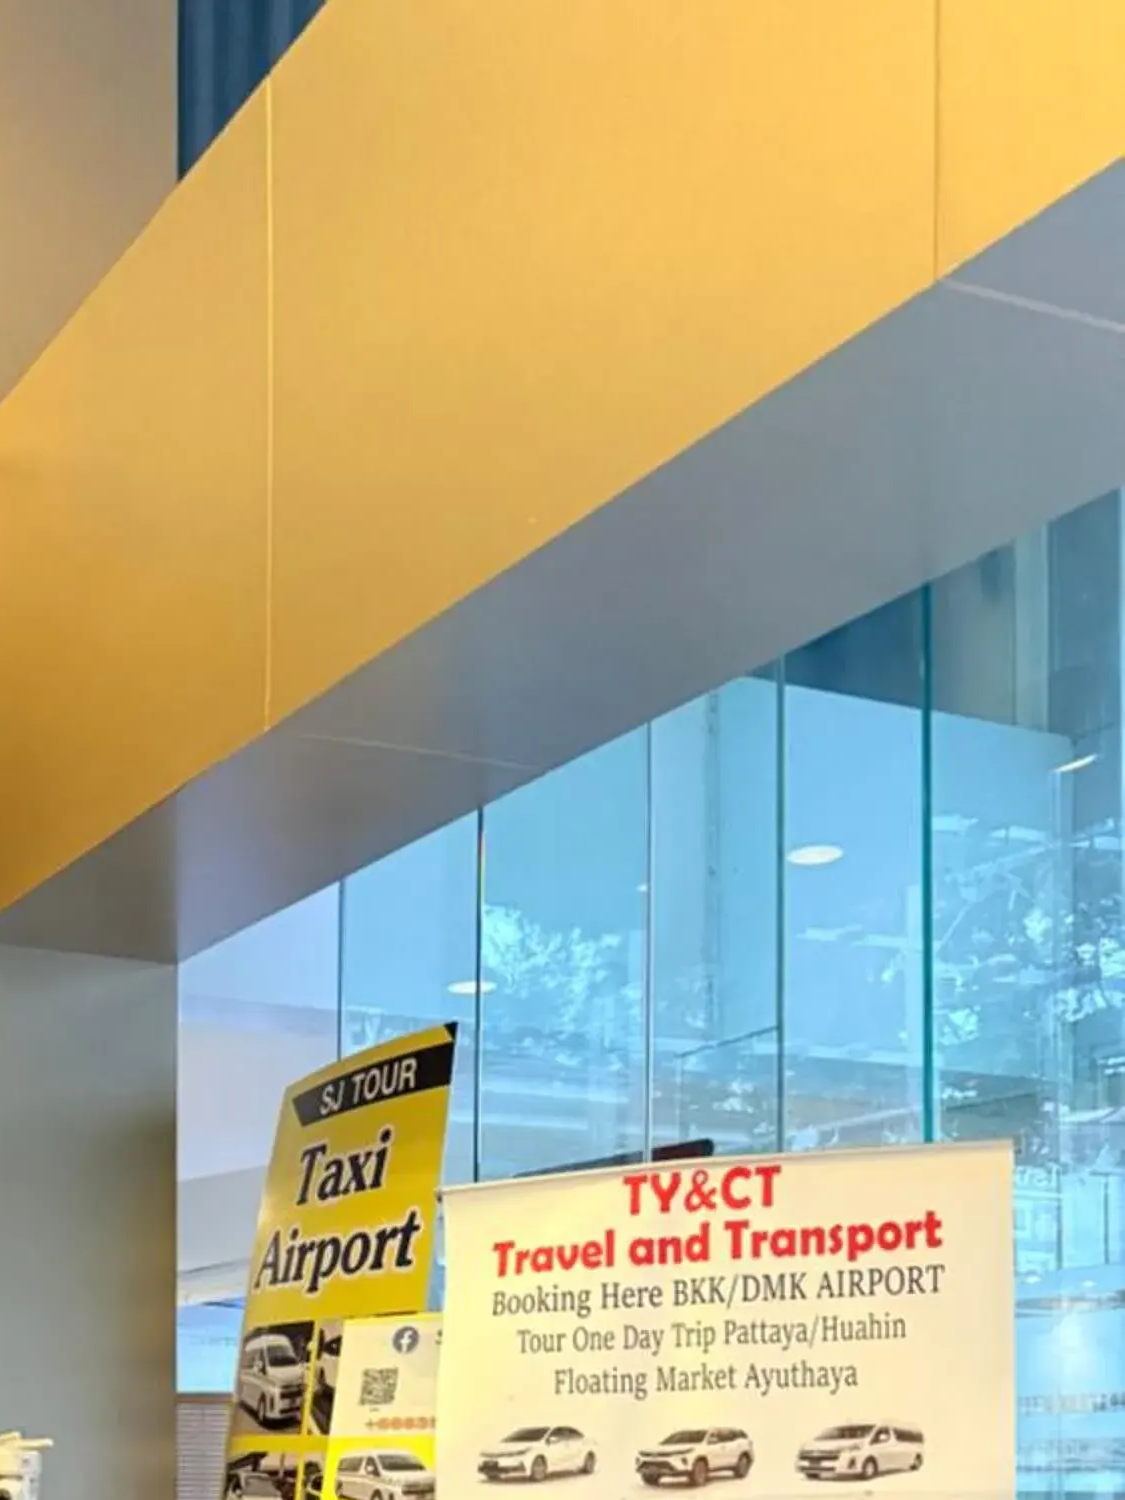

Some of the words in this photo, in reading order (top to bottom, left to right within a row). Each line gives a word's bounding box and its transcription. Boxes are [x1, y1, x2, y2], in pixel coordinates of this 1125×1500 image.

[319, 1079, 345, 1115] SJ
[352, 1058, 418, 1104] TOUR
[296, 1128, 392, 1205] Taxi
[623, 1165, 782, 1215] TY&CT
[254, 1211, 420, 1293] Airport
[493, 1229, 615, 1277] Travel
[628, 1221, 711, 1268] and
[724, 1210, 944, 1262] Transport
[491, 1281, 591, 1317] Booking
[600, 1279, 664, 1309] Here
[672, 1272, 808, 1309] BKK/DMK
[818, 1264, 946, 1299] AIRPORT
[517, 1329, 564, 1354] Tour
[572, 1327, 615, 1352] One
[622, 1324, 665, 1357] Day
[670, 1323, 717, 1354] Trip
[723, 1313, 908, 1353] Pattaya/Huahin
[553, 1368, 648, 1400] Floating
[655, 1364, 737, 1394] Market
[744, 1361, 859, 1395] Ayuthaya
